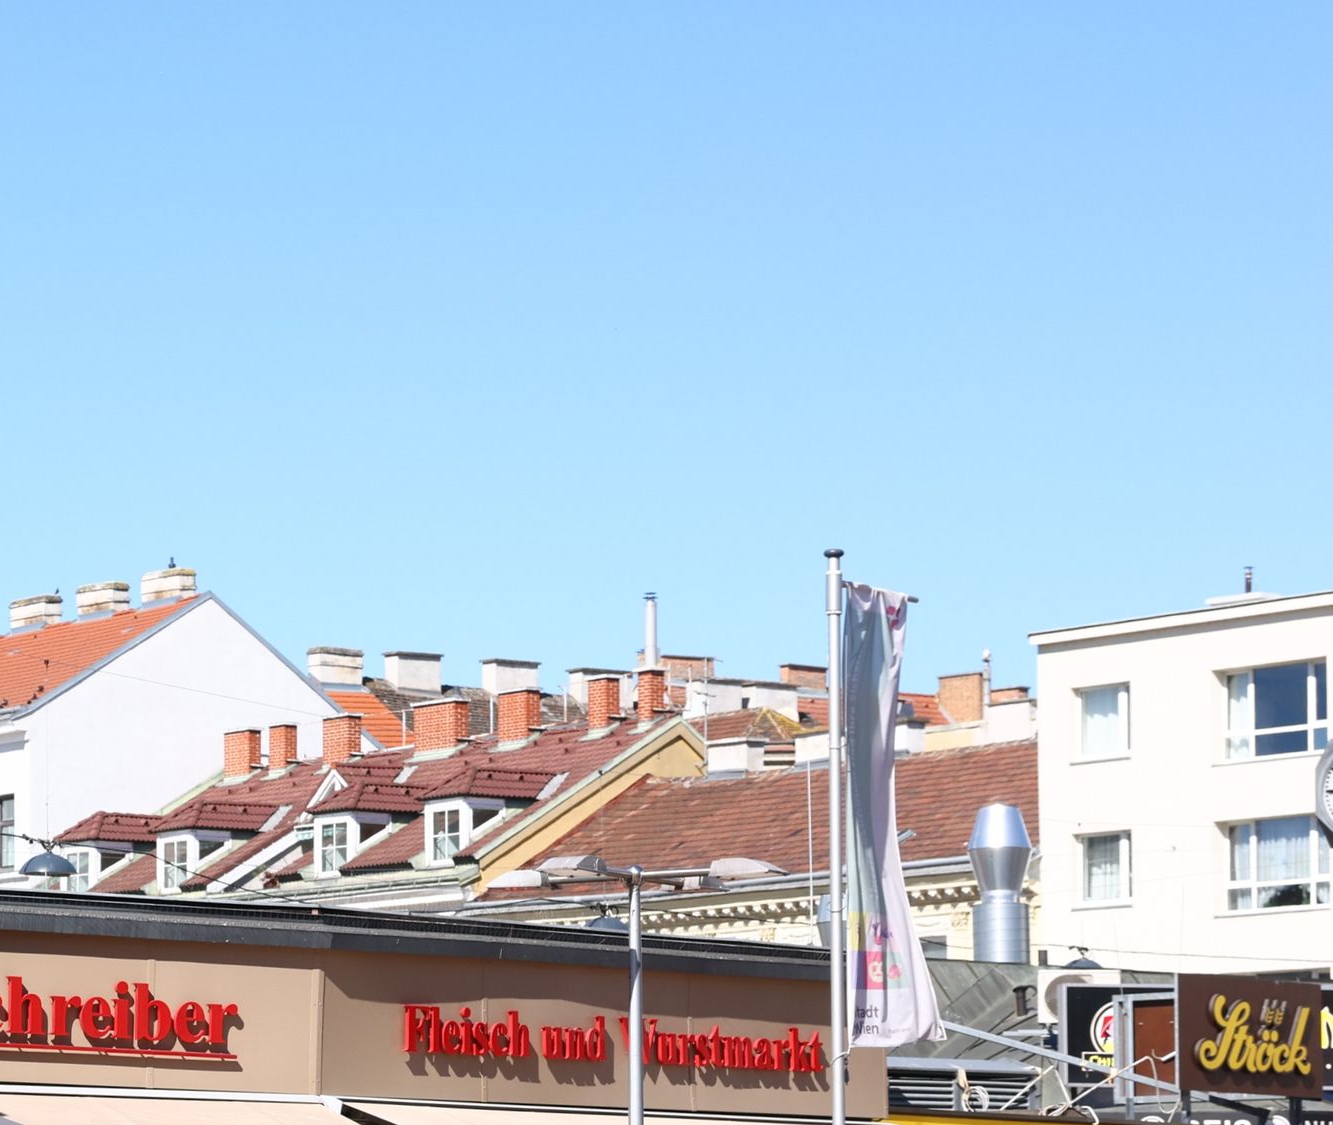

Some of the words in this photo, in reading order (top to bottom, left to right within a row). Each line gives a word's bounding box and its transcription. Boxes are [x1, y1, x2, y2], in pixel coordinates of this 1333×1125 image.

[403, 1005, 531, 1057] Fleisch
[541, 1016, 610, 1062] und
[618, 1017, 824, 1072] Wurstmarkt
[855, 1003, 879, 1018] tadt
[1197, 993, 1312, 1075] Ströck
